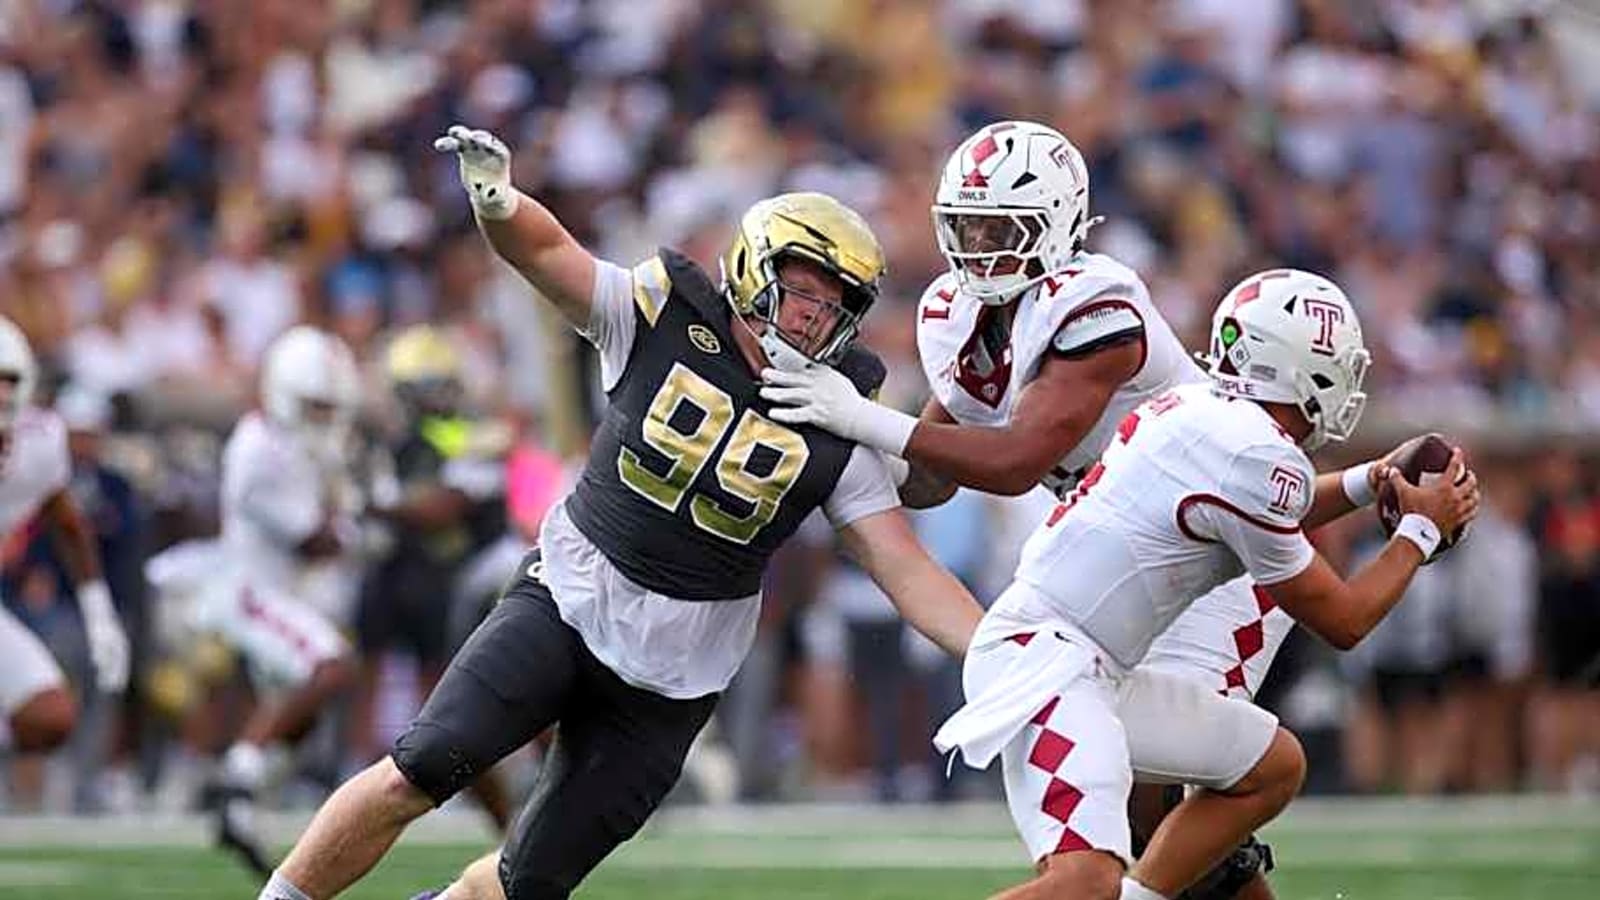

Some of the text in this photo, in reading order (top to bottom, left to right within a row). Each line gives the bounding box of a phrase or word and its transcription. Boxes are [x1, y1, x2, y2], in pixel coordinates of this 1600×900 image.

[958, 190, 987, 201] OWLS
[1303, 298, 1345, 358] T
[617, 361, 811, 545] 99
[1267, 466, 1304, 516] T
